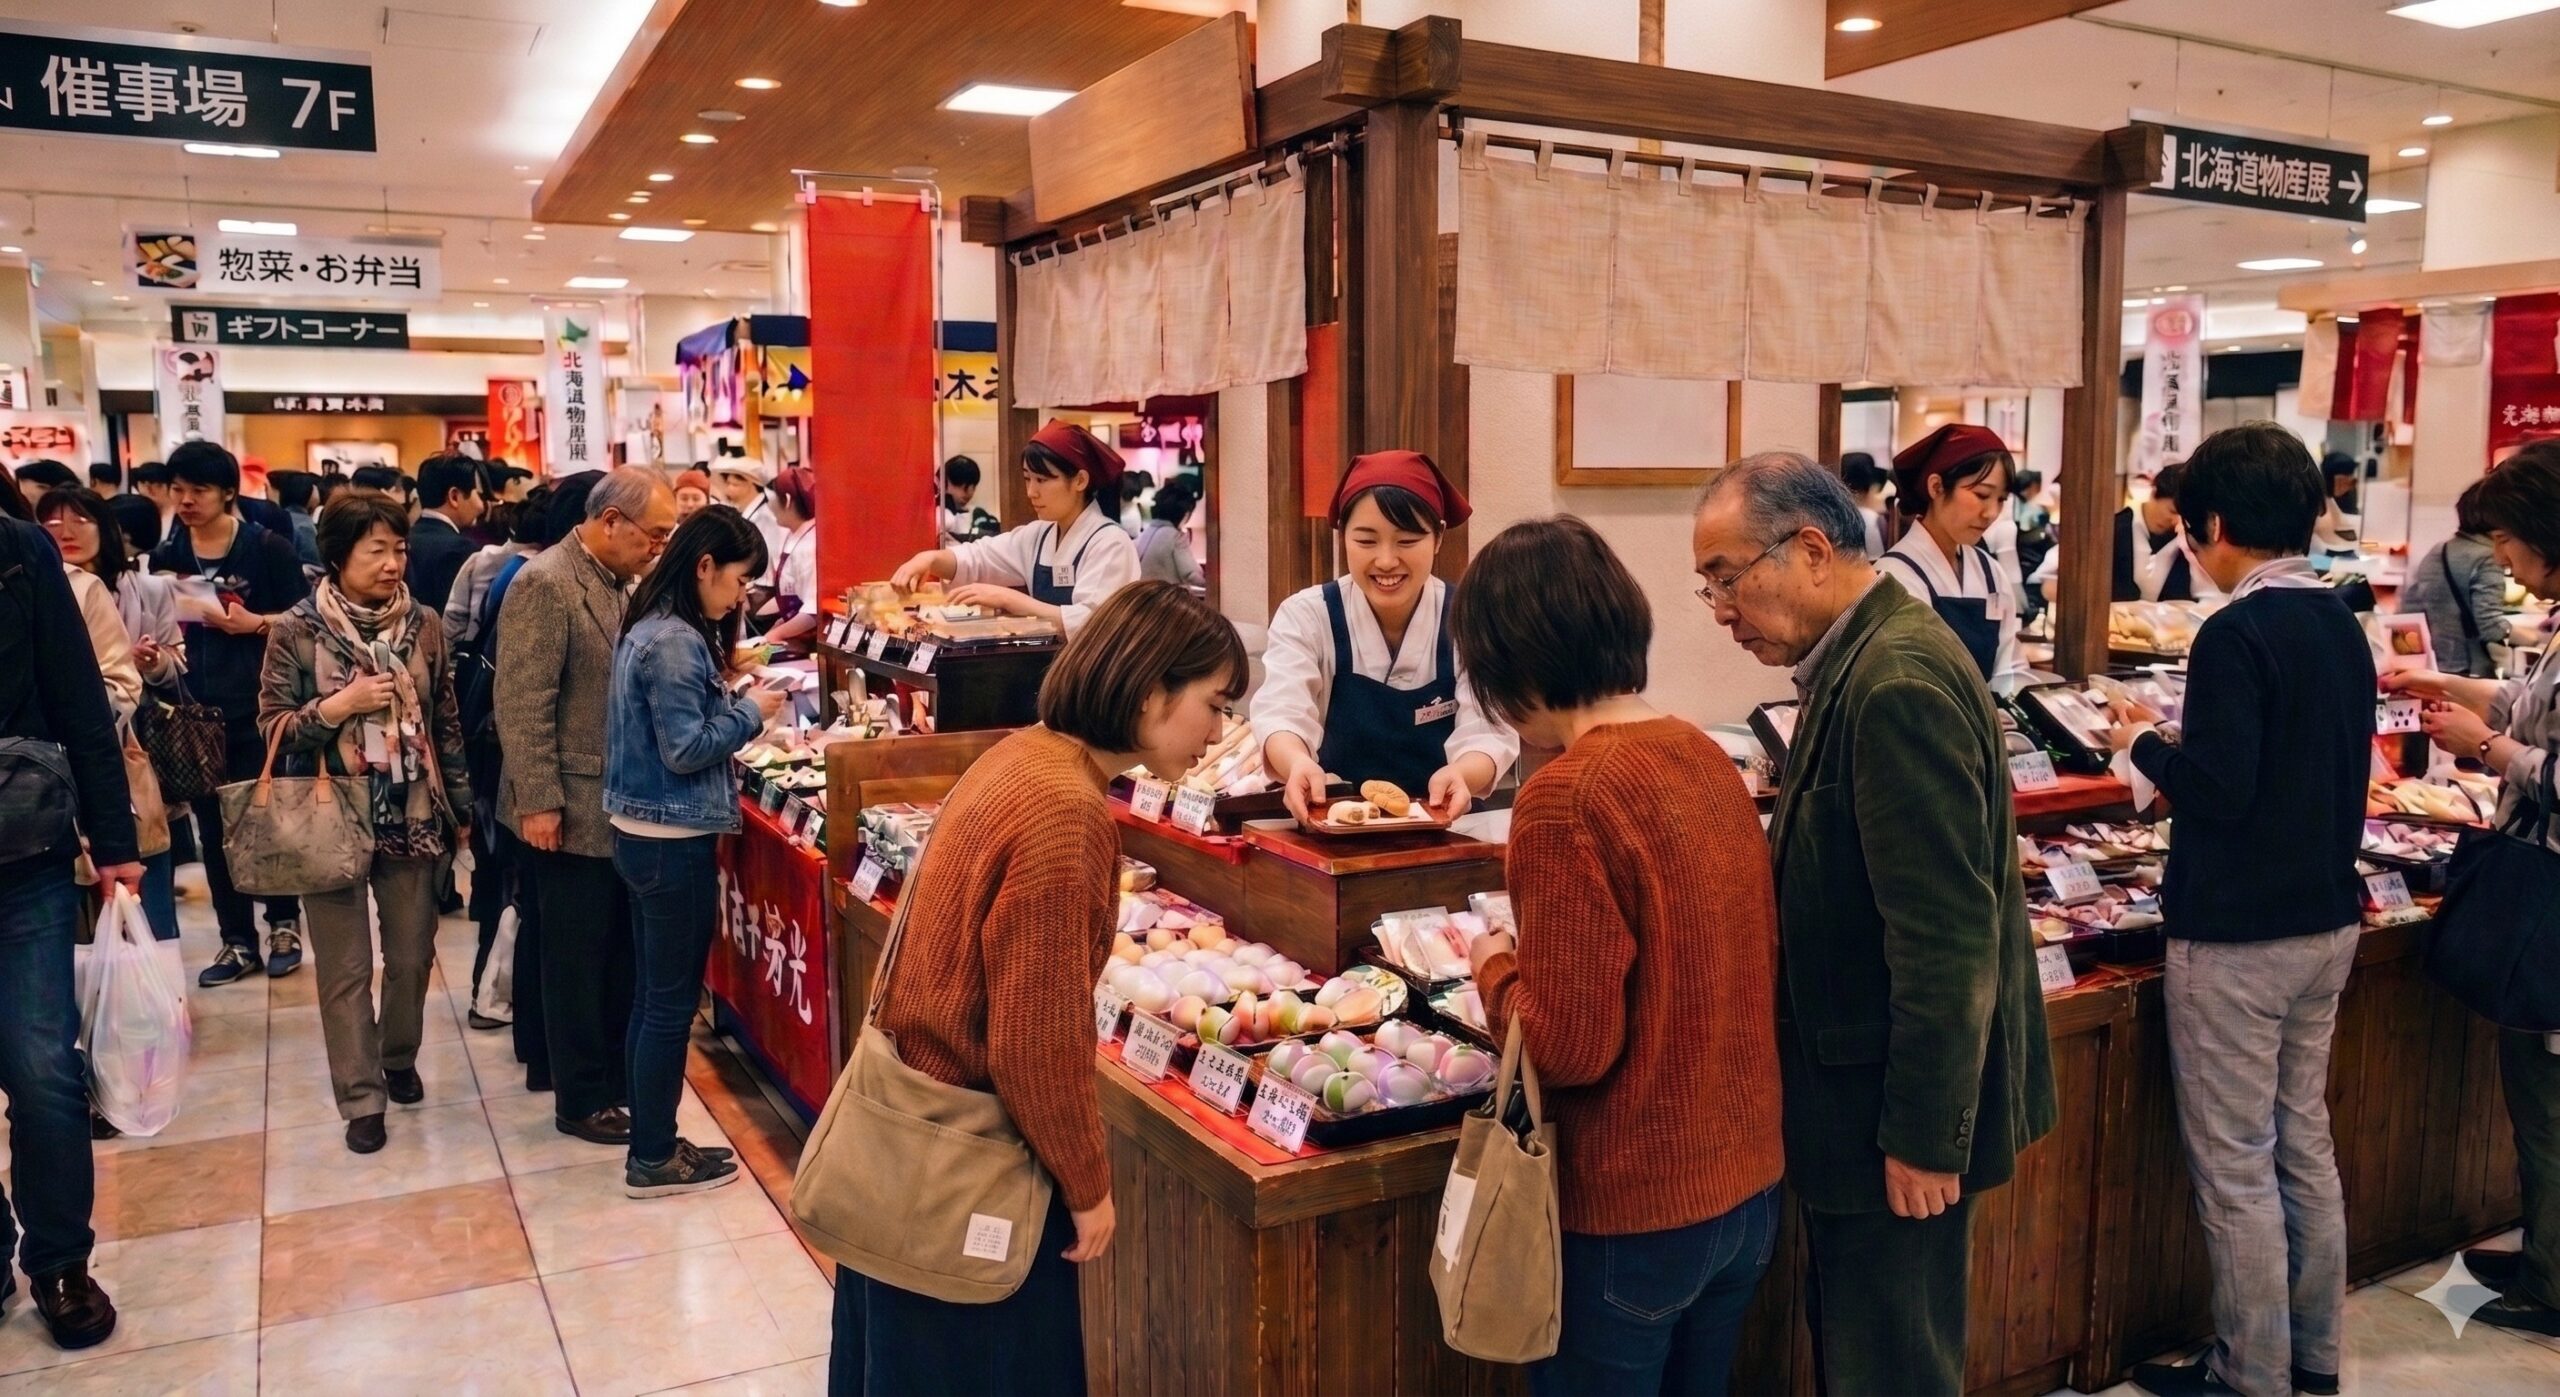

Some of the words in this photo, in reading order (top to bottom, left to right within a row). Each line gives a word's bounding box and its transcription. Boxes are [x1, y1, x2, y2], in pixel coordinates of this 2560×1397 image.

[41, 55, 248, 127] 催事場
[282, 77, 356, 131] 7F
[2182, 142, 2331, 205] 北海道物産展
[219, 248, 421, 289] 惣菜・お弁当
[227, 315, 400, 341] ギフトコーナー
